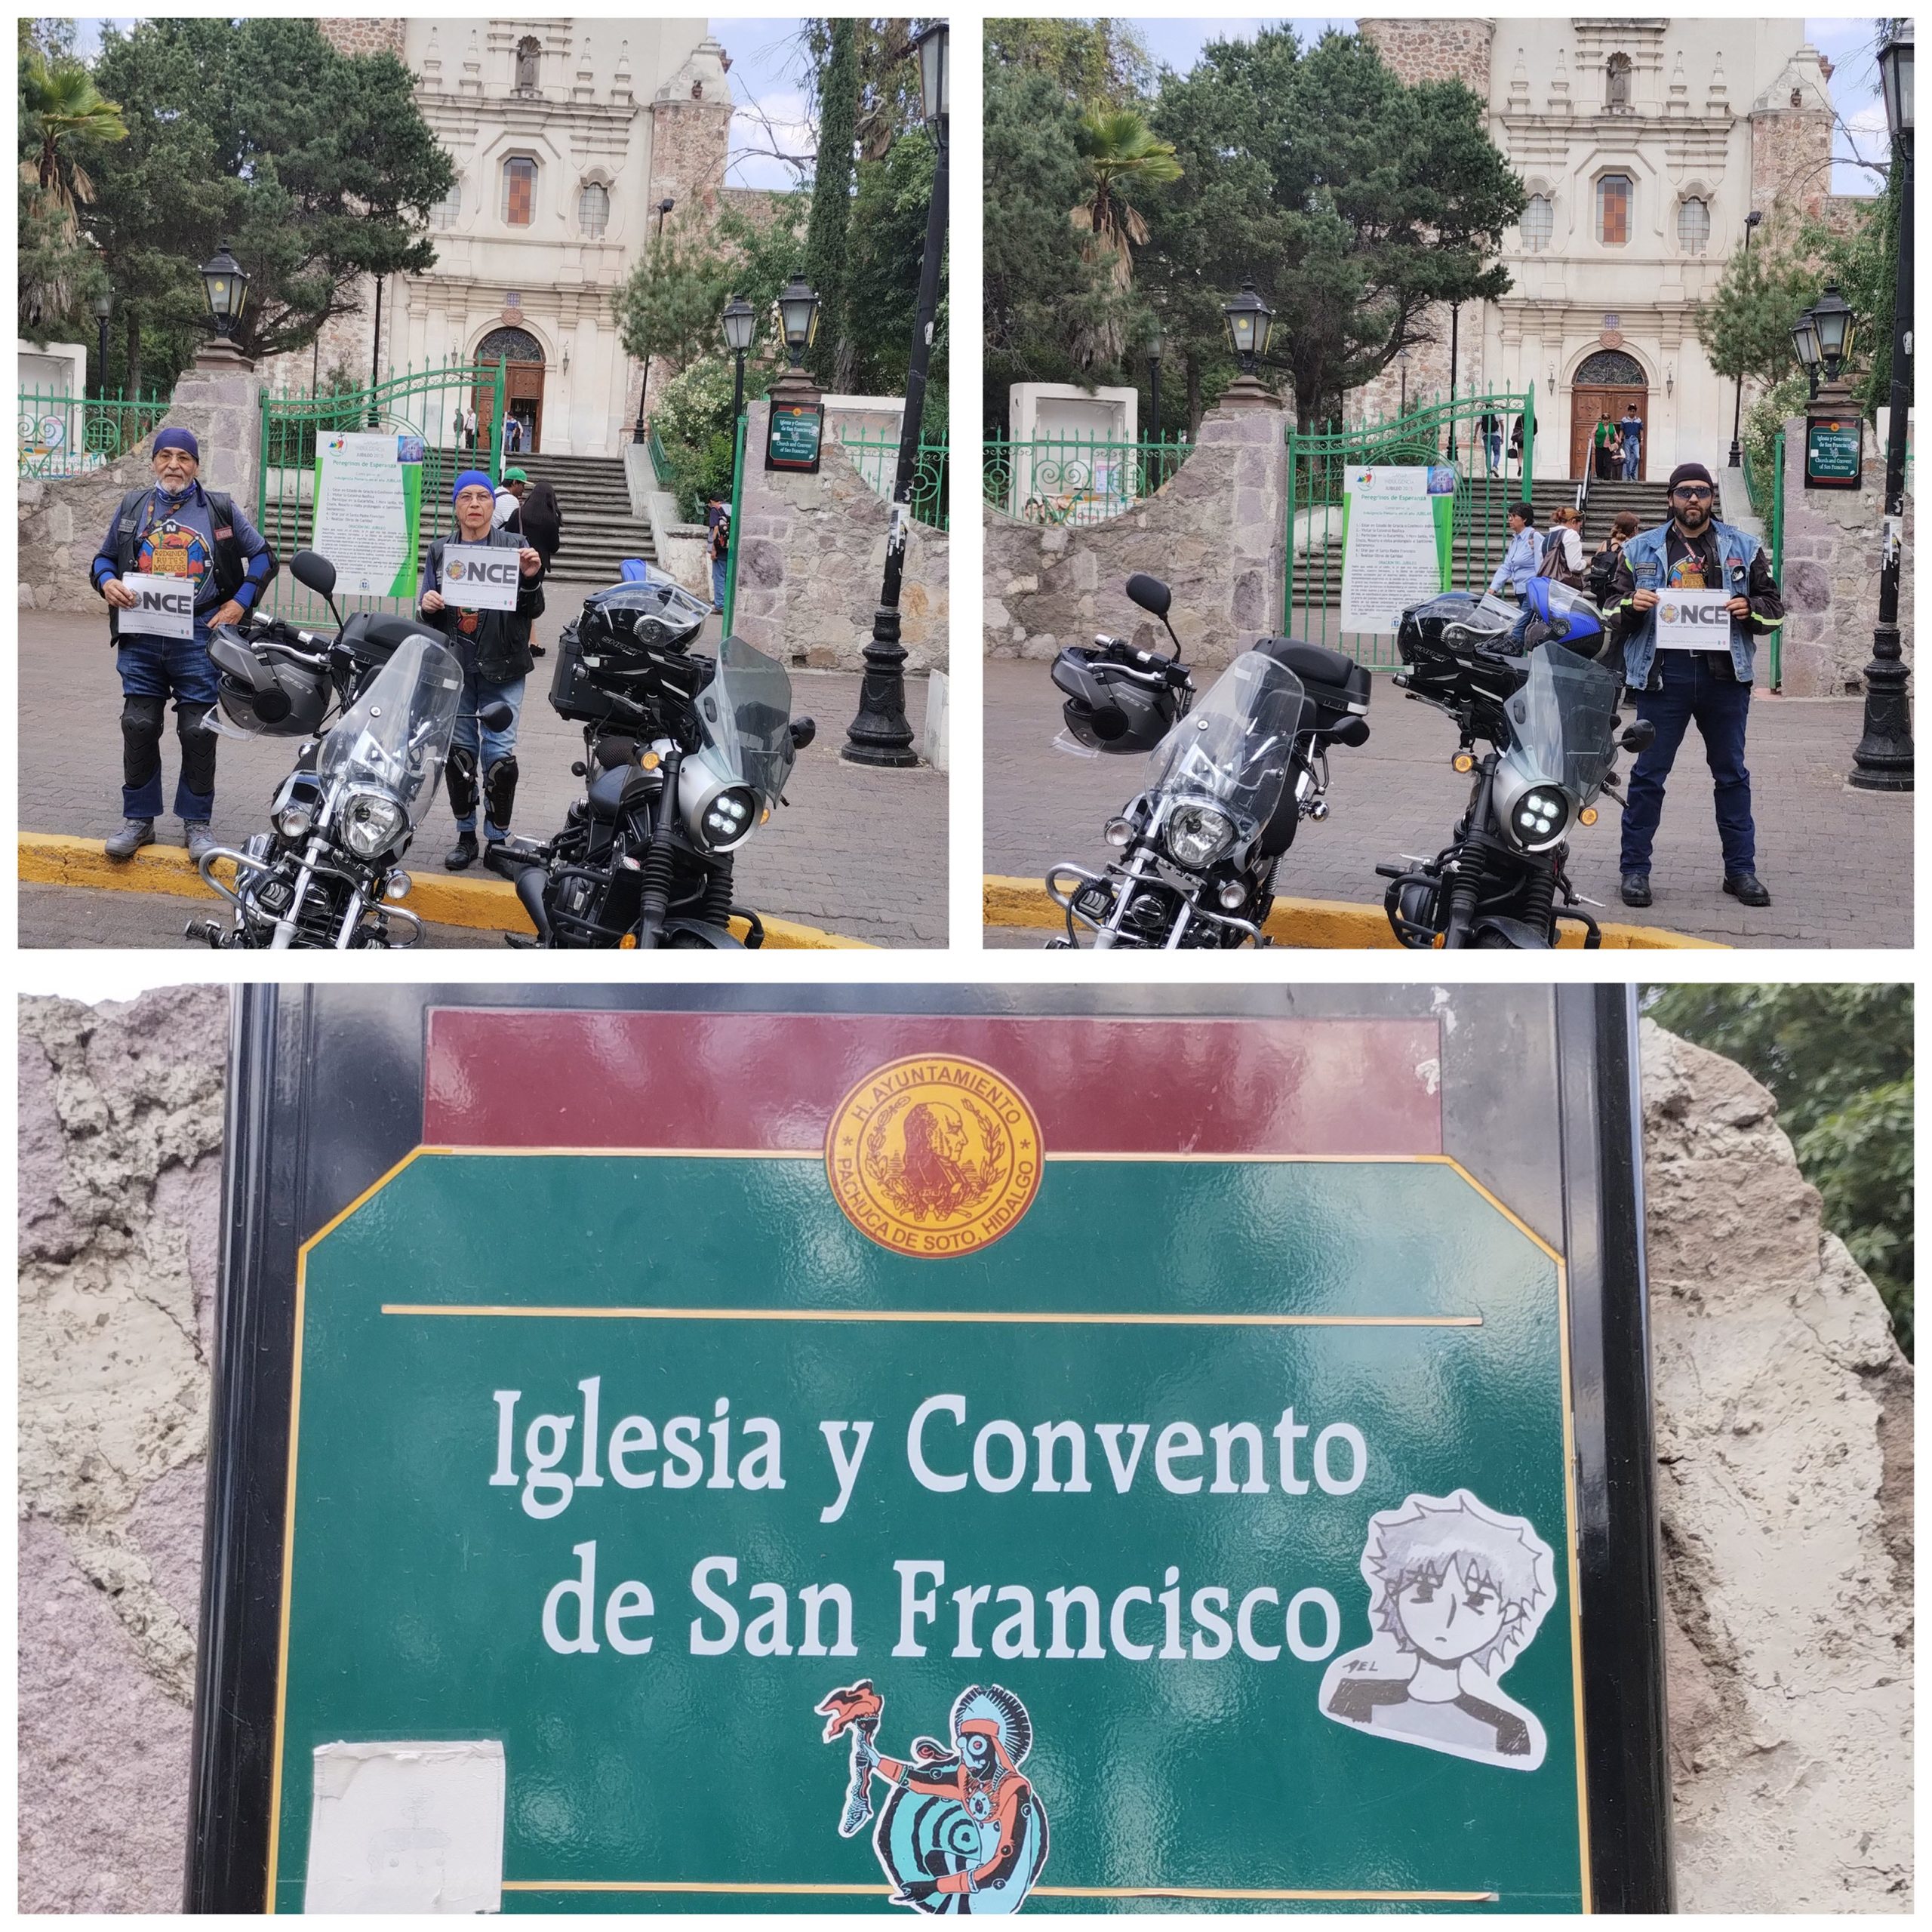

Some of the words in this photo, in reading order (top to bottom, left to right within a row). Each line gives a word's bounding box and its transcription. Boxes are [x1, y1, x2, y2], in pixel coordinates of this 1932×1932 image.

[851, 1105, 872, 1121] H.
[872, 1066, 1020, 1124] AYUNTAMIENTO
[836, 1158, 893, 1237] PACHUCA
[892, 1228, 918, 1249] DE
[924, 1230, 983, 1251] SOTO,
[981, 1161, 1033, 1235] HIDALGO
[490, 1377, 786, 1519] Iglesia
[820, 1421, 874, 1523] y
[907, 1394, 1367, 1496] Convento
[542, 1540, 654, 1655] de
[690, 1556, 858, 1657] San
[892, 1560, 1341, 1661] Francisco
